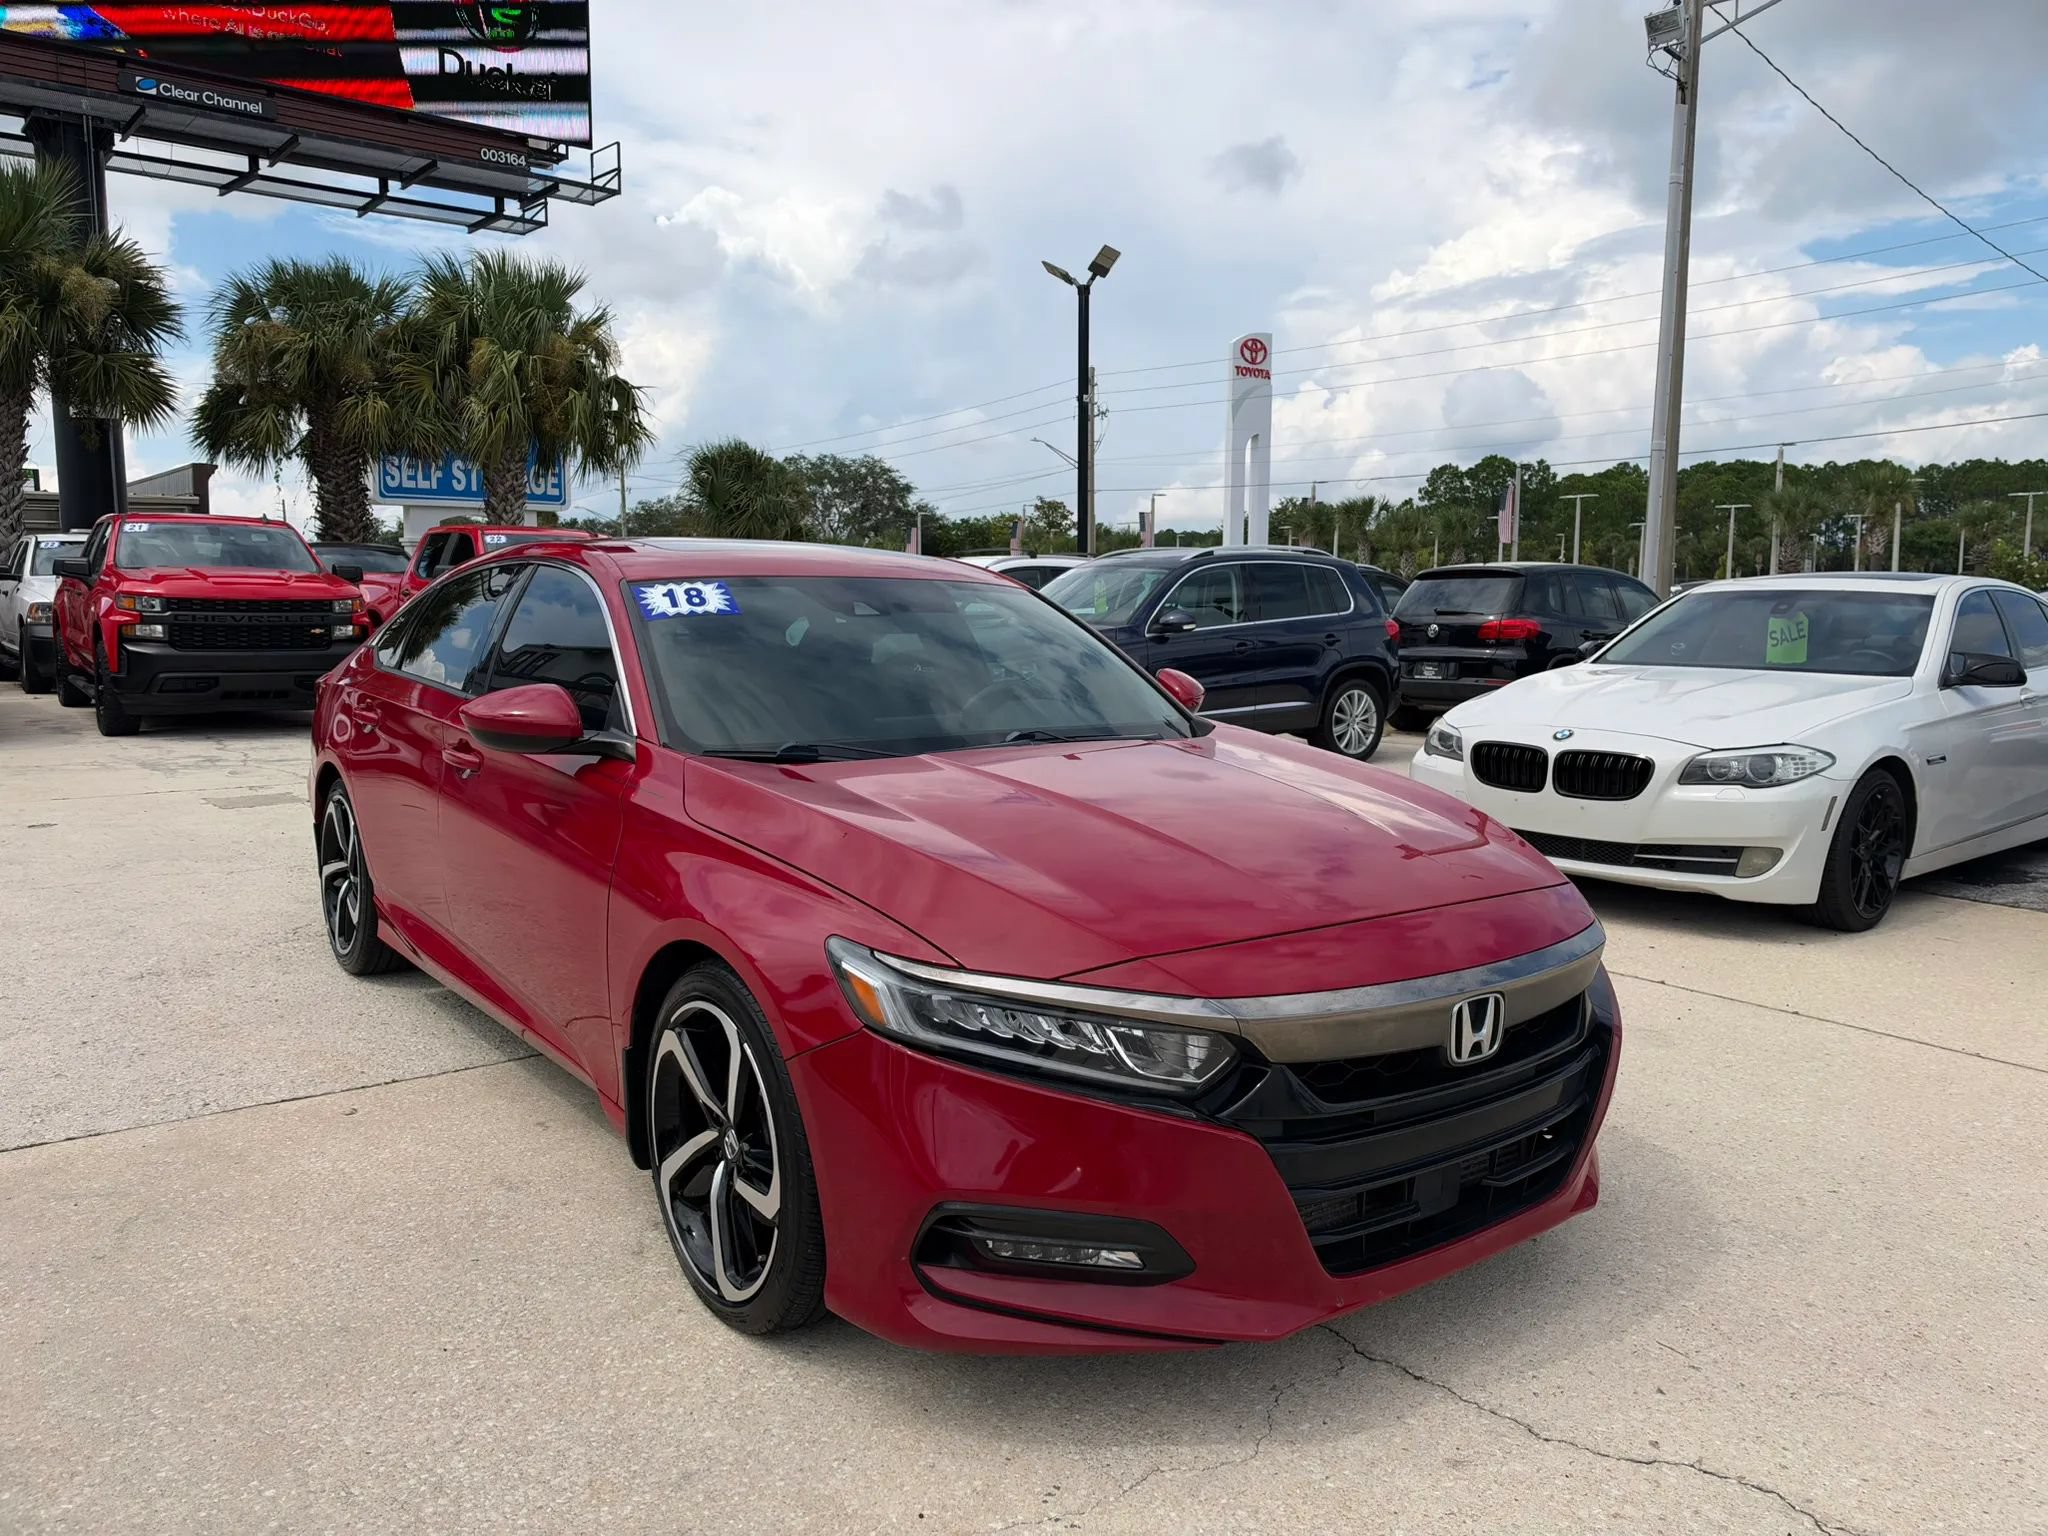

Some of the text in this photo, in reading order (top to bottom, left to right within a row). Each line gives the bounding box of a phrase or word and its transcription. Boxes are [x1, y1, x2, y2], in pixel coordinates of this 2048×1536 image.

[159, 82, 263, 114] Clear Channel
[480, 147, 527, 167] 003164
[1234, 365, 1271, 380] TOYOTA
[385, 455, 560, 496] SELF STGE
[662, 587, 707, 608] 18
[173, 614, 329, 623] CHEVROLET
[1769, 620, 1806, 648] SALE
